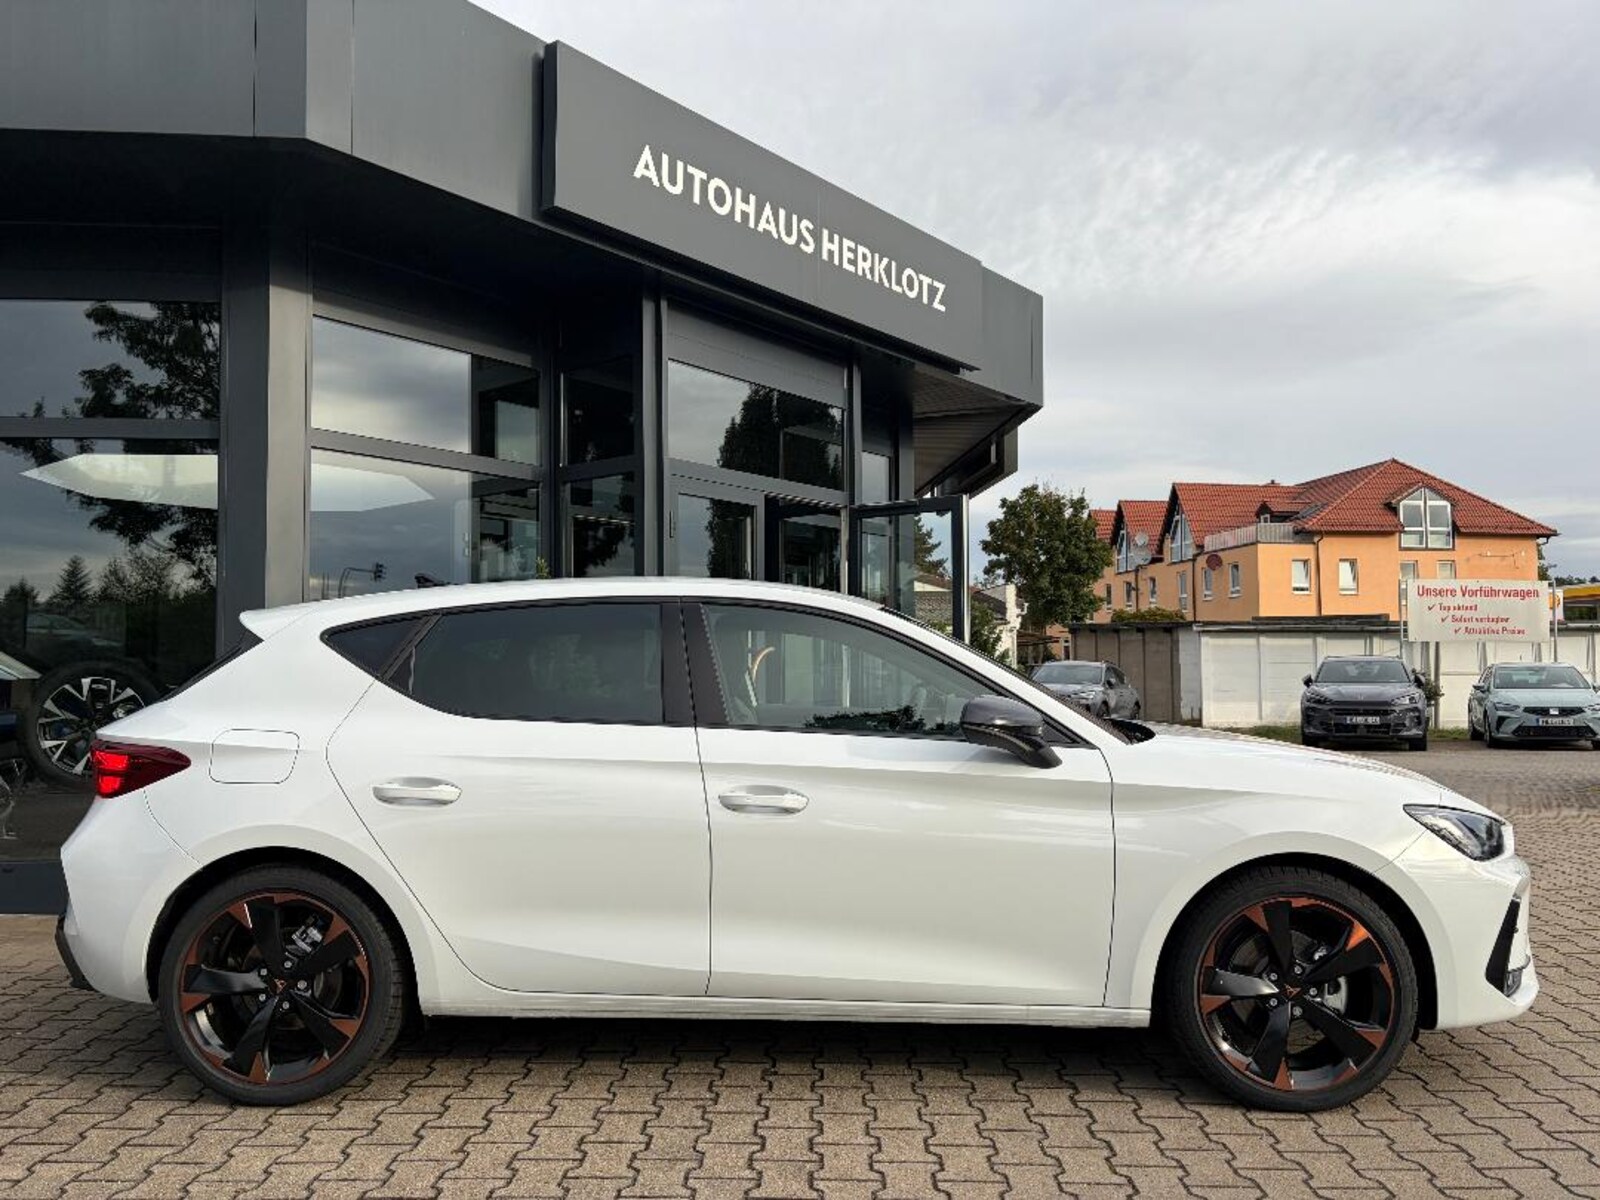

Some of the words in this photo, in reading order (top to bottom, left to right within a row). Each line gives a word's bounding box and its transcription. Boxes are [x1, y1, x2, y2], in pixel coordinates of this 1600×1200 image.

[633, 144, 815, 254] AUTOHAUS
[822, 228, 947, 313] HERKLOTZ
[1417, 585, 1457, 598] Unsere
[1460, 585, 1539, 600] Vorführwagen
